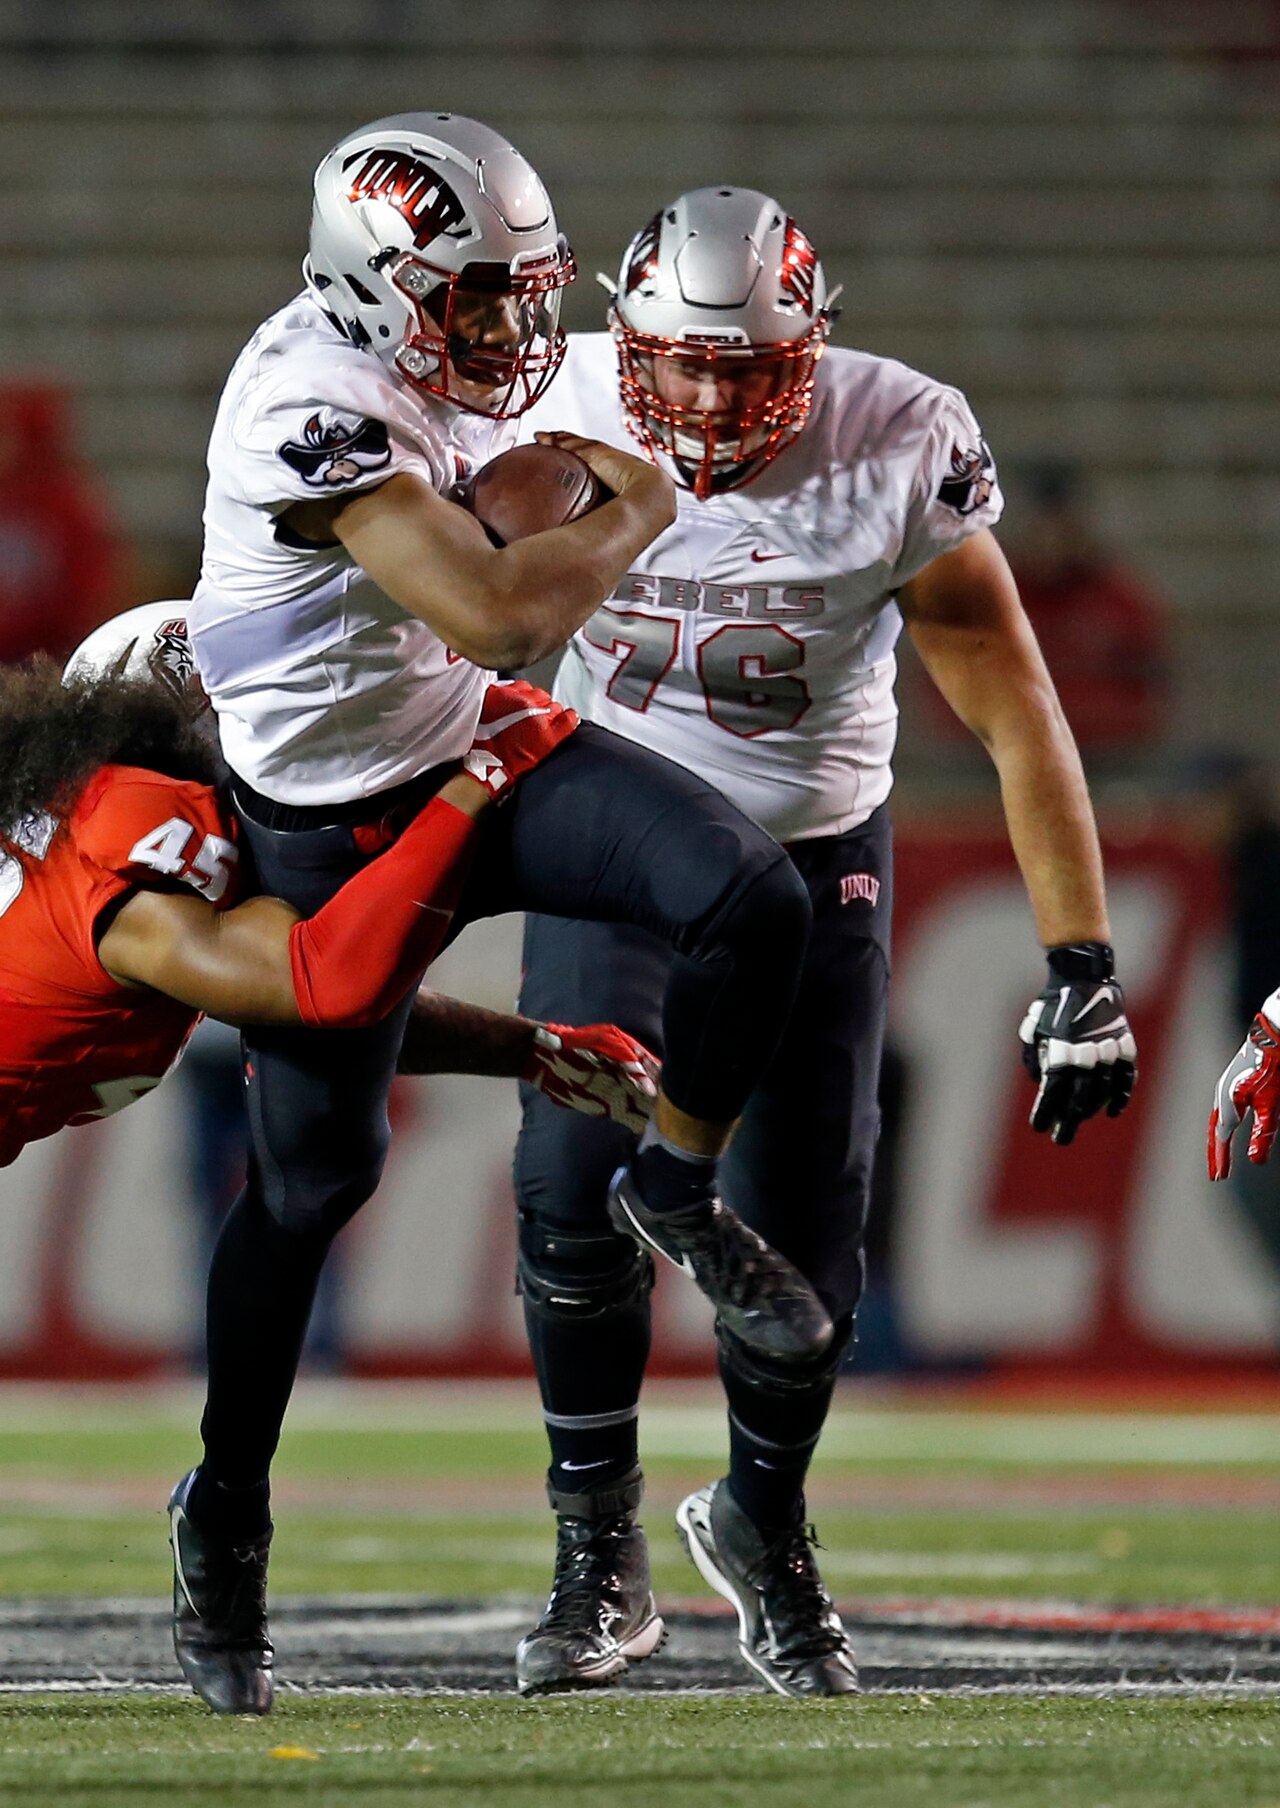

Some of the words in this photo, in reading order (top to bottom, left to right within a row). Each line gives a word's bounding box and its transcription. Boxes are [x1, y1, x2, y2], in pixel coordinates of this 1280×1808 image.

[346, 150, 466, 251] UNLV
[611, 573, 825, 617] EBELS
[583, 606, 812, 738] 76
[127, 816, 239, 902] 45
